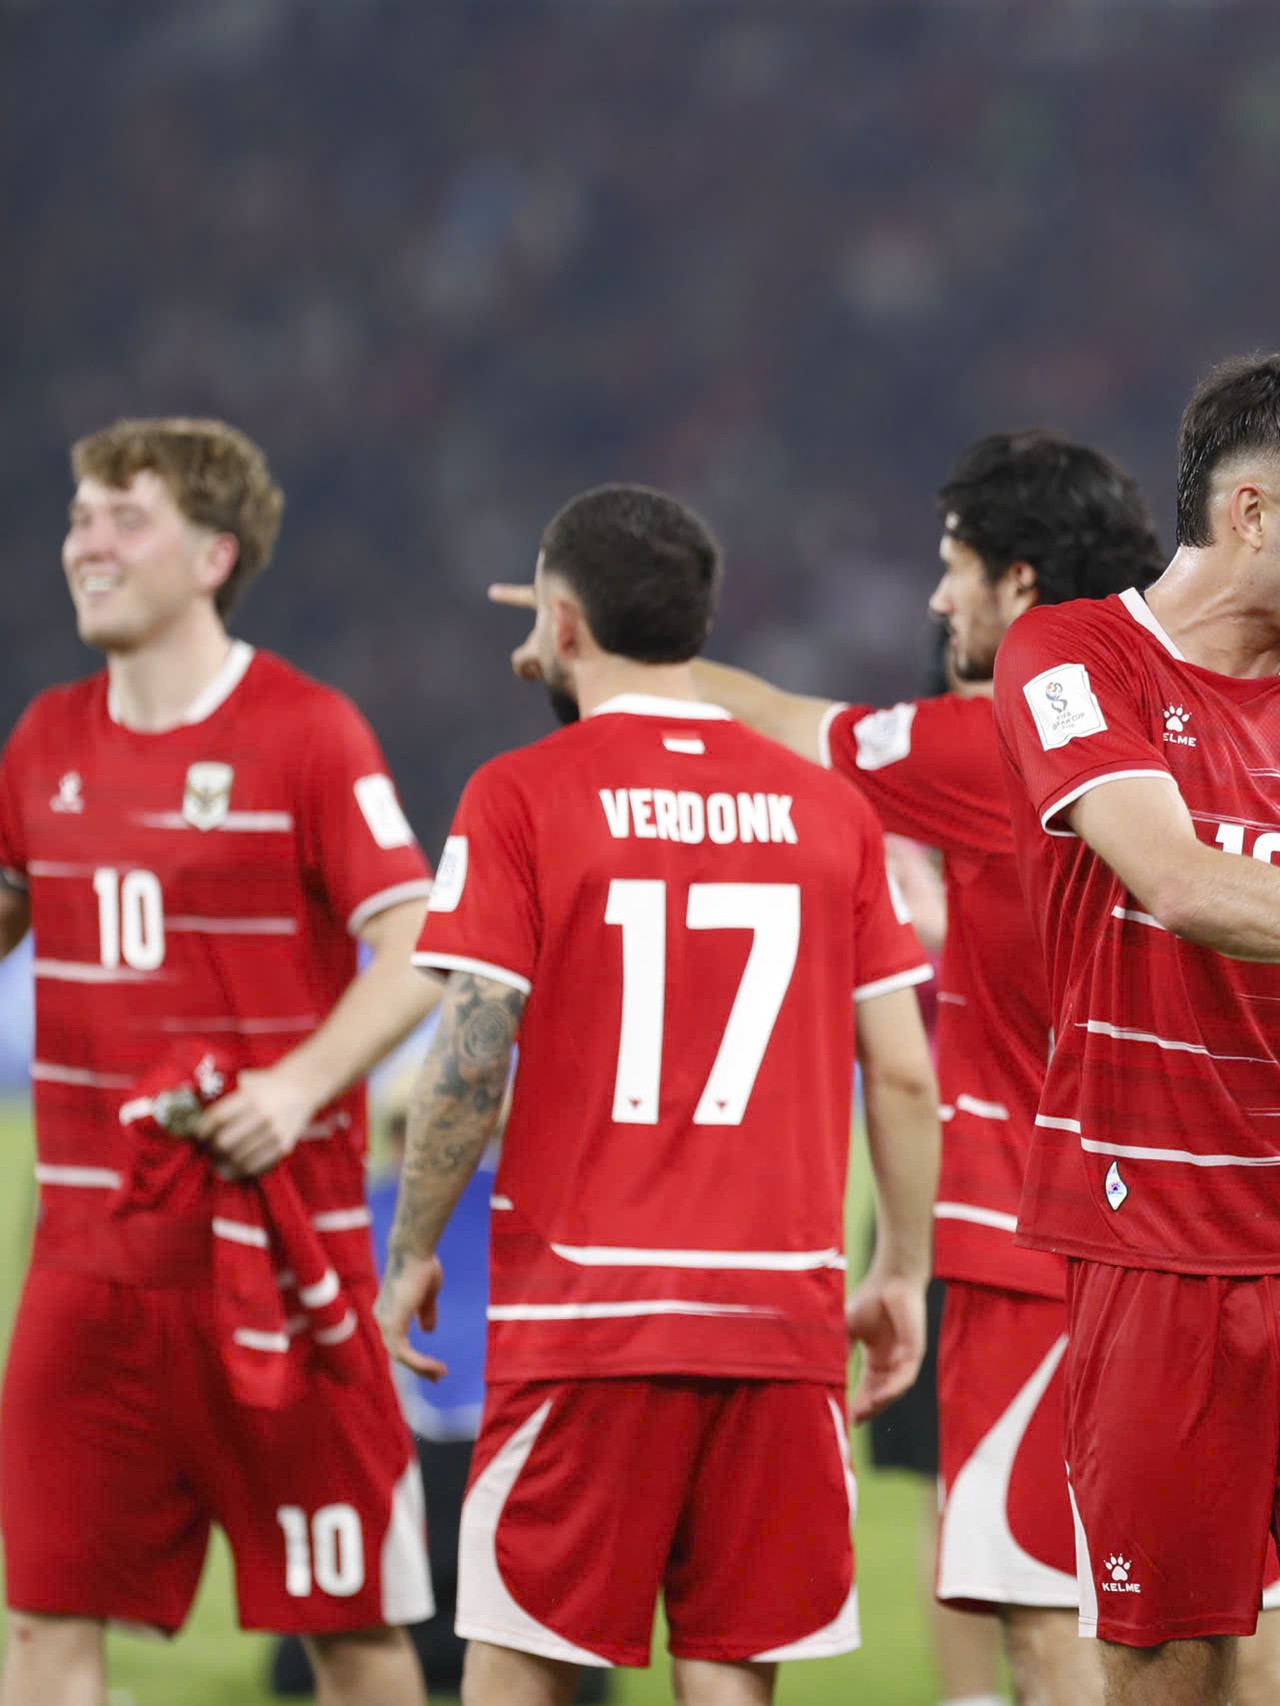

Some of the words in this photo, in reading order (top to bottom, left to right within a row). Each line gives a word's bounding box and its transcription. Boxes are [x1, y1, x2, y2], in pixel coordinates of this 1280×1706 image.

[1162, 732, 1197, 748] ELME
[598, 788, 799, 845] VERDONK
[93, 866, 166, 971] 10
[604, 878, 801, 1126] 17
[276, 1503, 366, 1598] 10
[1101, 1582, 1142, 1594] KELME
